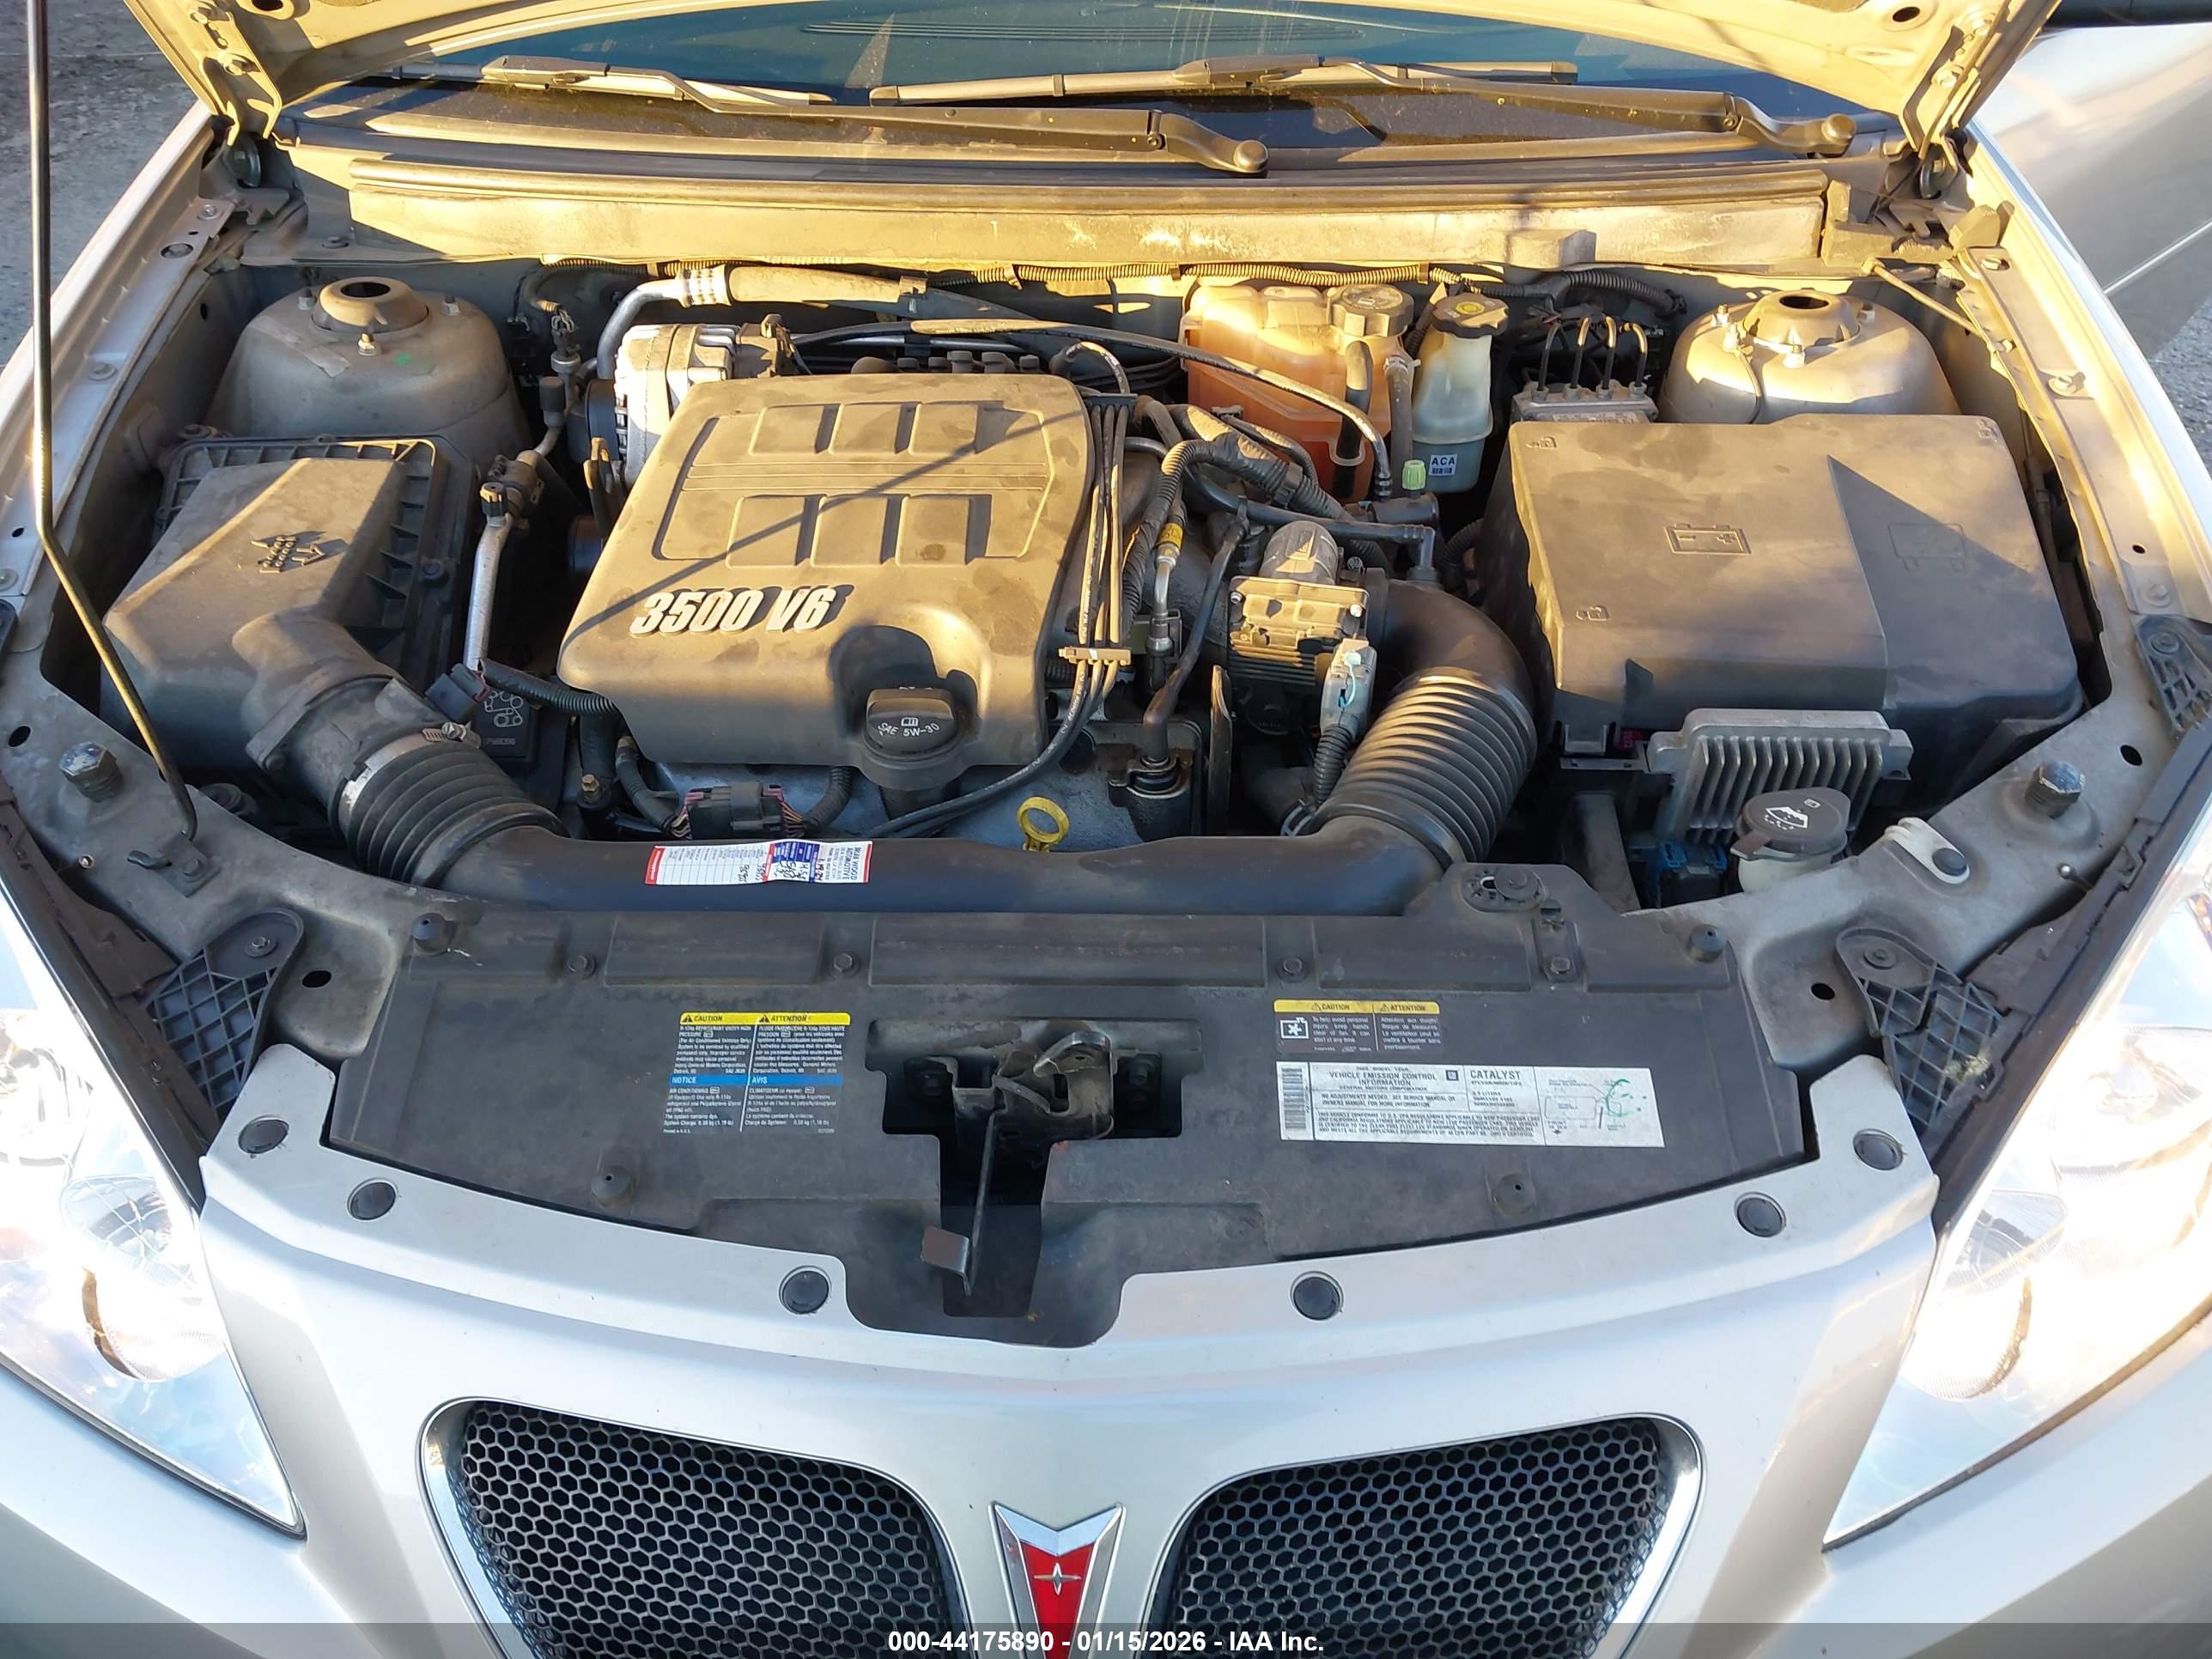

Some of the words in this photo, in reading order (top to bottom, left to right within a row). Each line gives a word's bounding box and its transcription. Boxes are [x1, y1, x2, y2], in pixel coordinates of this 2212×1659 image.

[1431, 457, 1455, 466] ACA
[629, 589, 765, 636] 3500
[765, 587, 838, 633] V6
[878, 721, 899, 736] SAE
[902, 722, 940, 737] 5W-30
[1470, 1070, 1521, 1080] CATALYST
